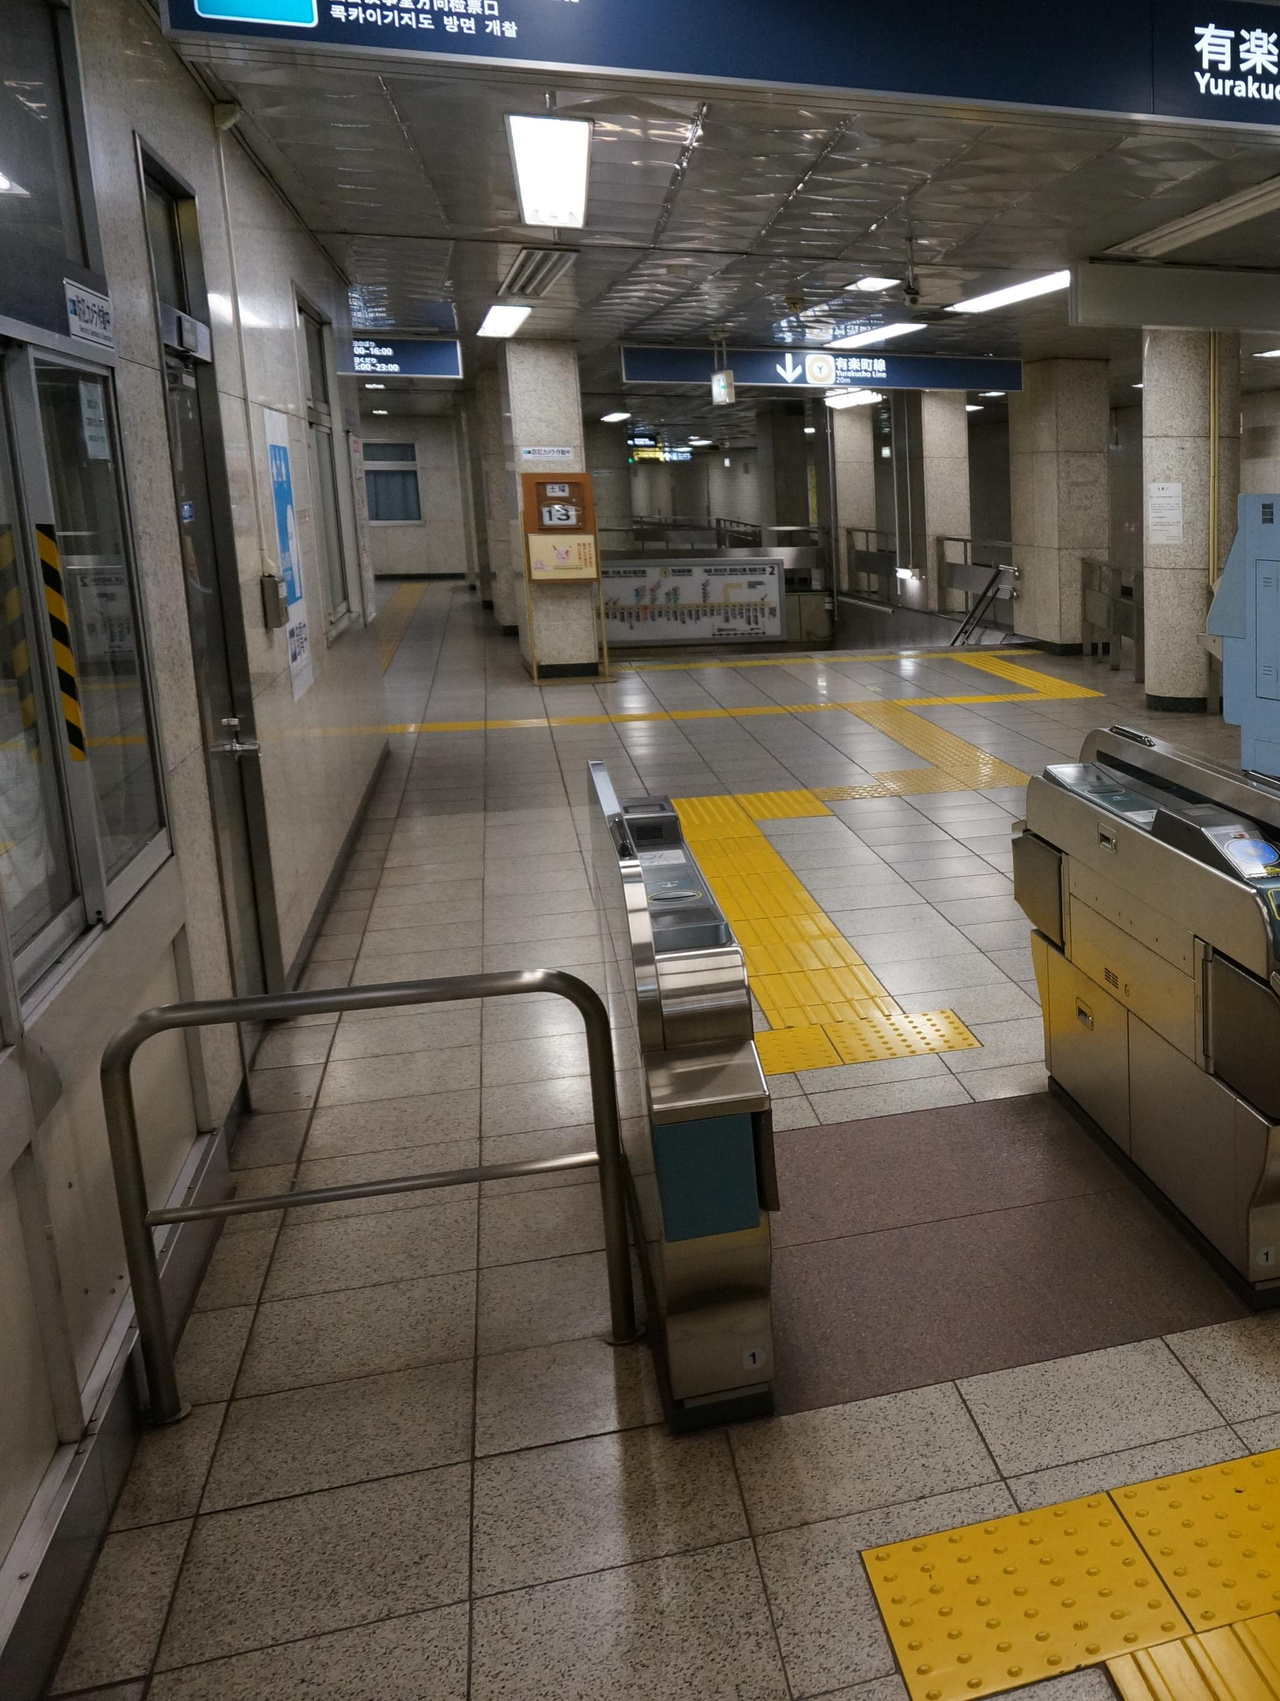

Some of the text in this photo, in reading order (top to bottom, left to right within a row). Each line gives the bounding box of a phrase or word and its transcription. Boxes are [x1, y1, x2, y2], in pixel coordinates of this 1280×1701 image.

[330, 5, 518, 38] 콕카이기지도 방면 개찰
[817, 365, 824, 374] Y
[836, 357, 887, 371] 有楽町線
[836, 369, 887, 378] Yurakucho Line
[836, 376, 851, 384] 20m
[546, 507, 571, 522] 13
[768, 566, 776, 576] 2
[1263, 1251, 1270, 1262] 1
[749, 1352, 756, 1364] 1
